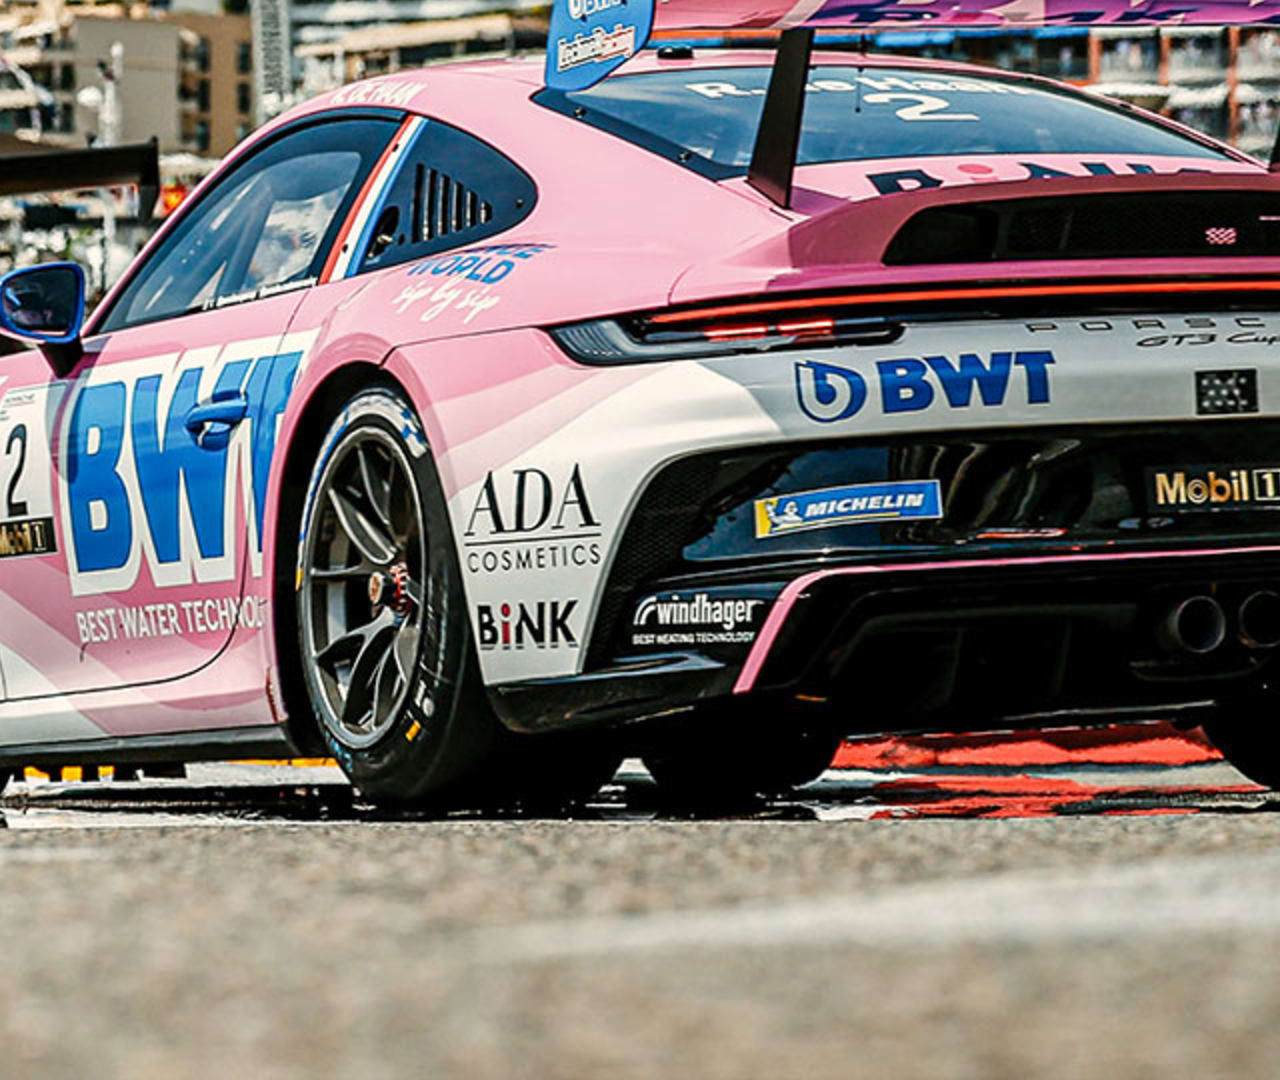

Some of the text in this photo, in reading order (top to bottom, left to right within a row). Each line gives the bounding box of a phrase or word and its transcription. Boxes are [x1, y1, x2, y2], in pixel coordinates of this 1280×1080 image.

[863, 92, 981, 121] 2
[1136, 333, 1217, 347] GT3
[876, 350, 1057, 414] BWT
[5, 423, 29, 518] 2
[68, 349, 306, 574] BWT
[463, 461, 602, 537] ADA
[805, 492, 925, 518] MICHELIN
[1155, 470, 1250, 505] Mobil
[467, 543, 602, 573] COSMETICS
[76, 607, 118, 644] BEST
[120, 600, 182, 640] WATER
[656, 593, 765, 631] windhager
[632, 631, 756, 645] BEST HEATING TECHNOLOGY
